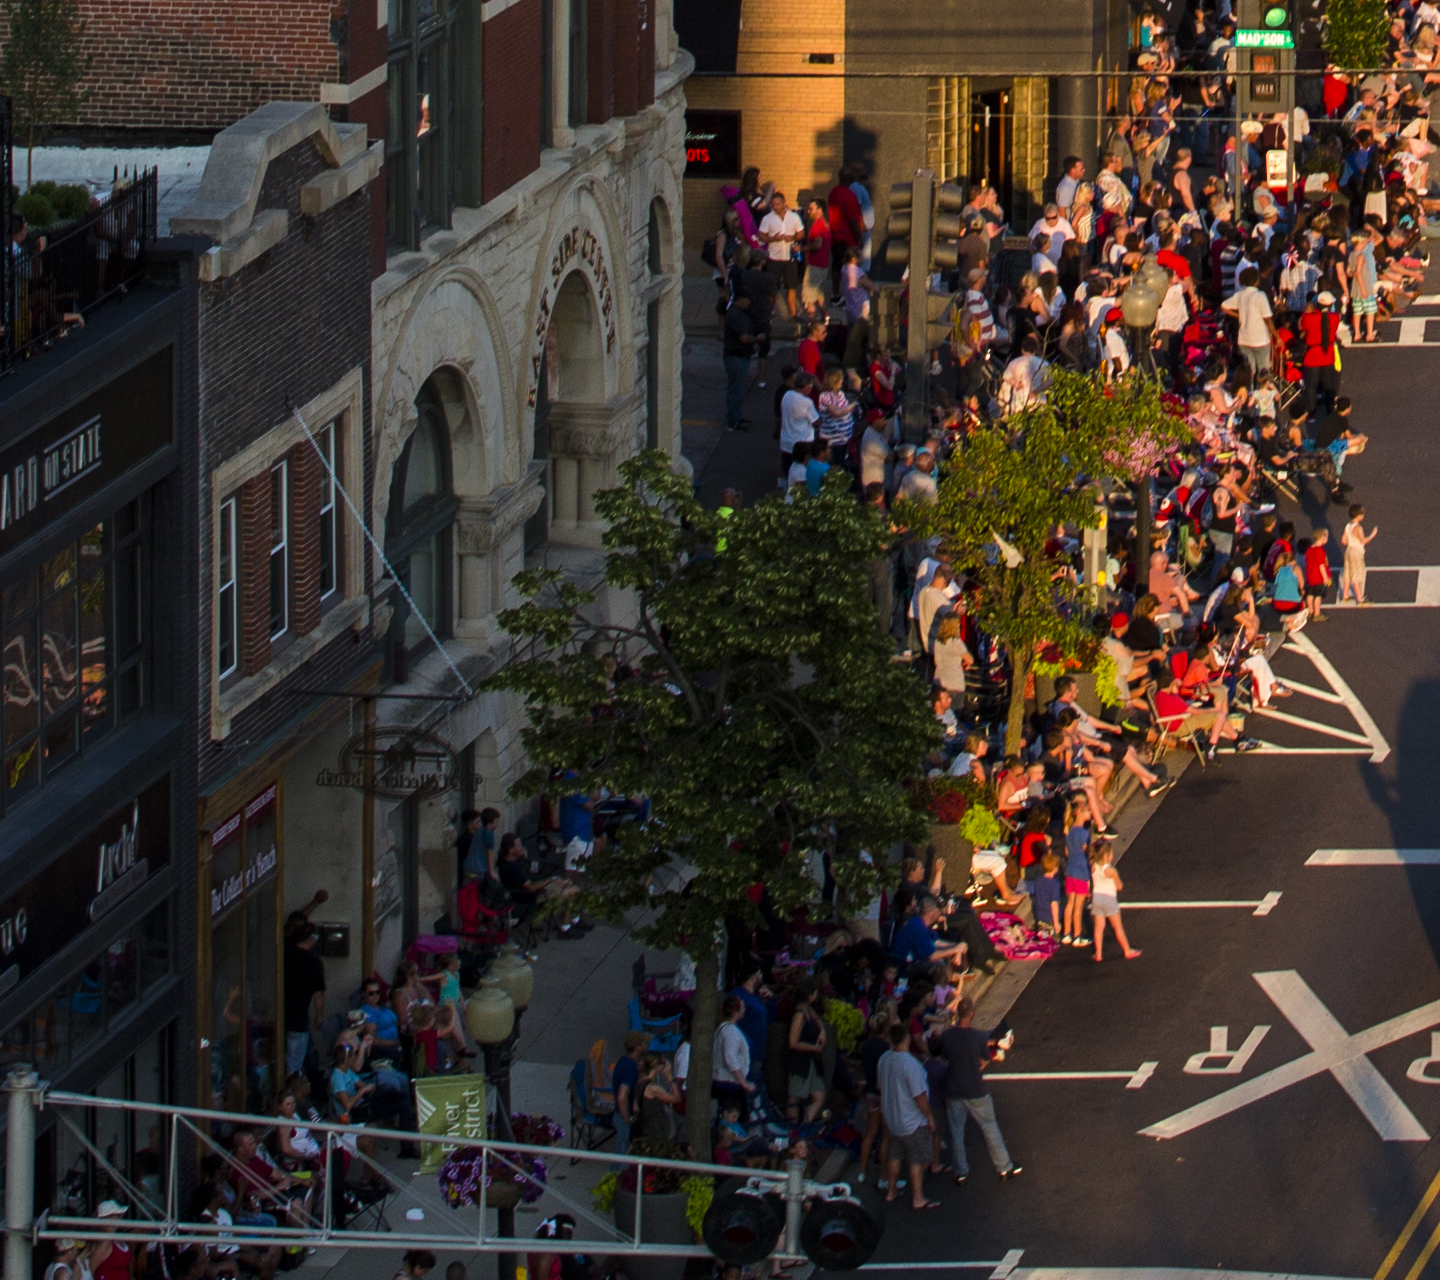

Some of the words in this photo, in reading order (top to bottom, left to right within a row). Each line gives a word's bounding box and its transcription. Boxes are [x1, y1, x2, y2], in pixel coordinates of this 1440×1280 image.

[1255, 84, 1275, 96] WALK
[44, 450, 60, 491] ON
[63, 423, 102, 479] STATE
